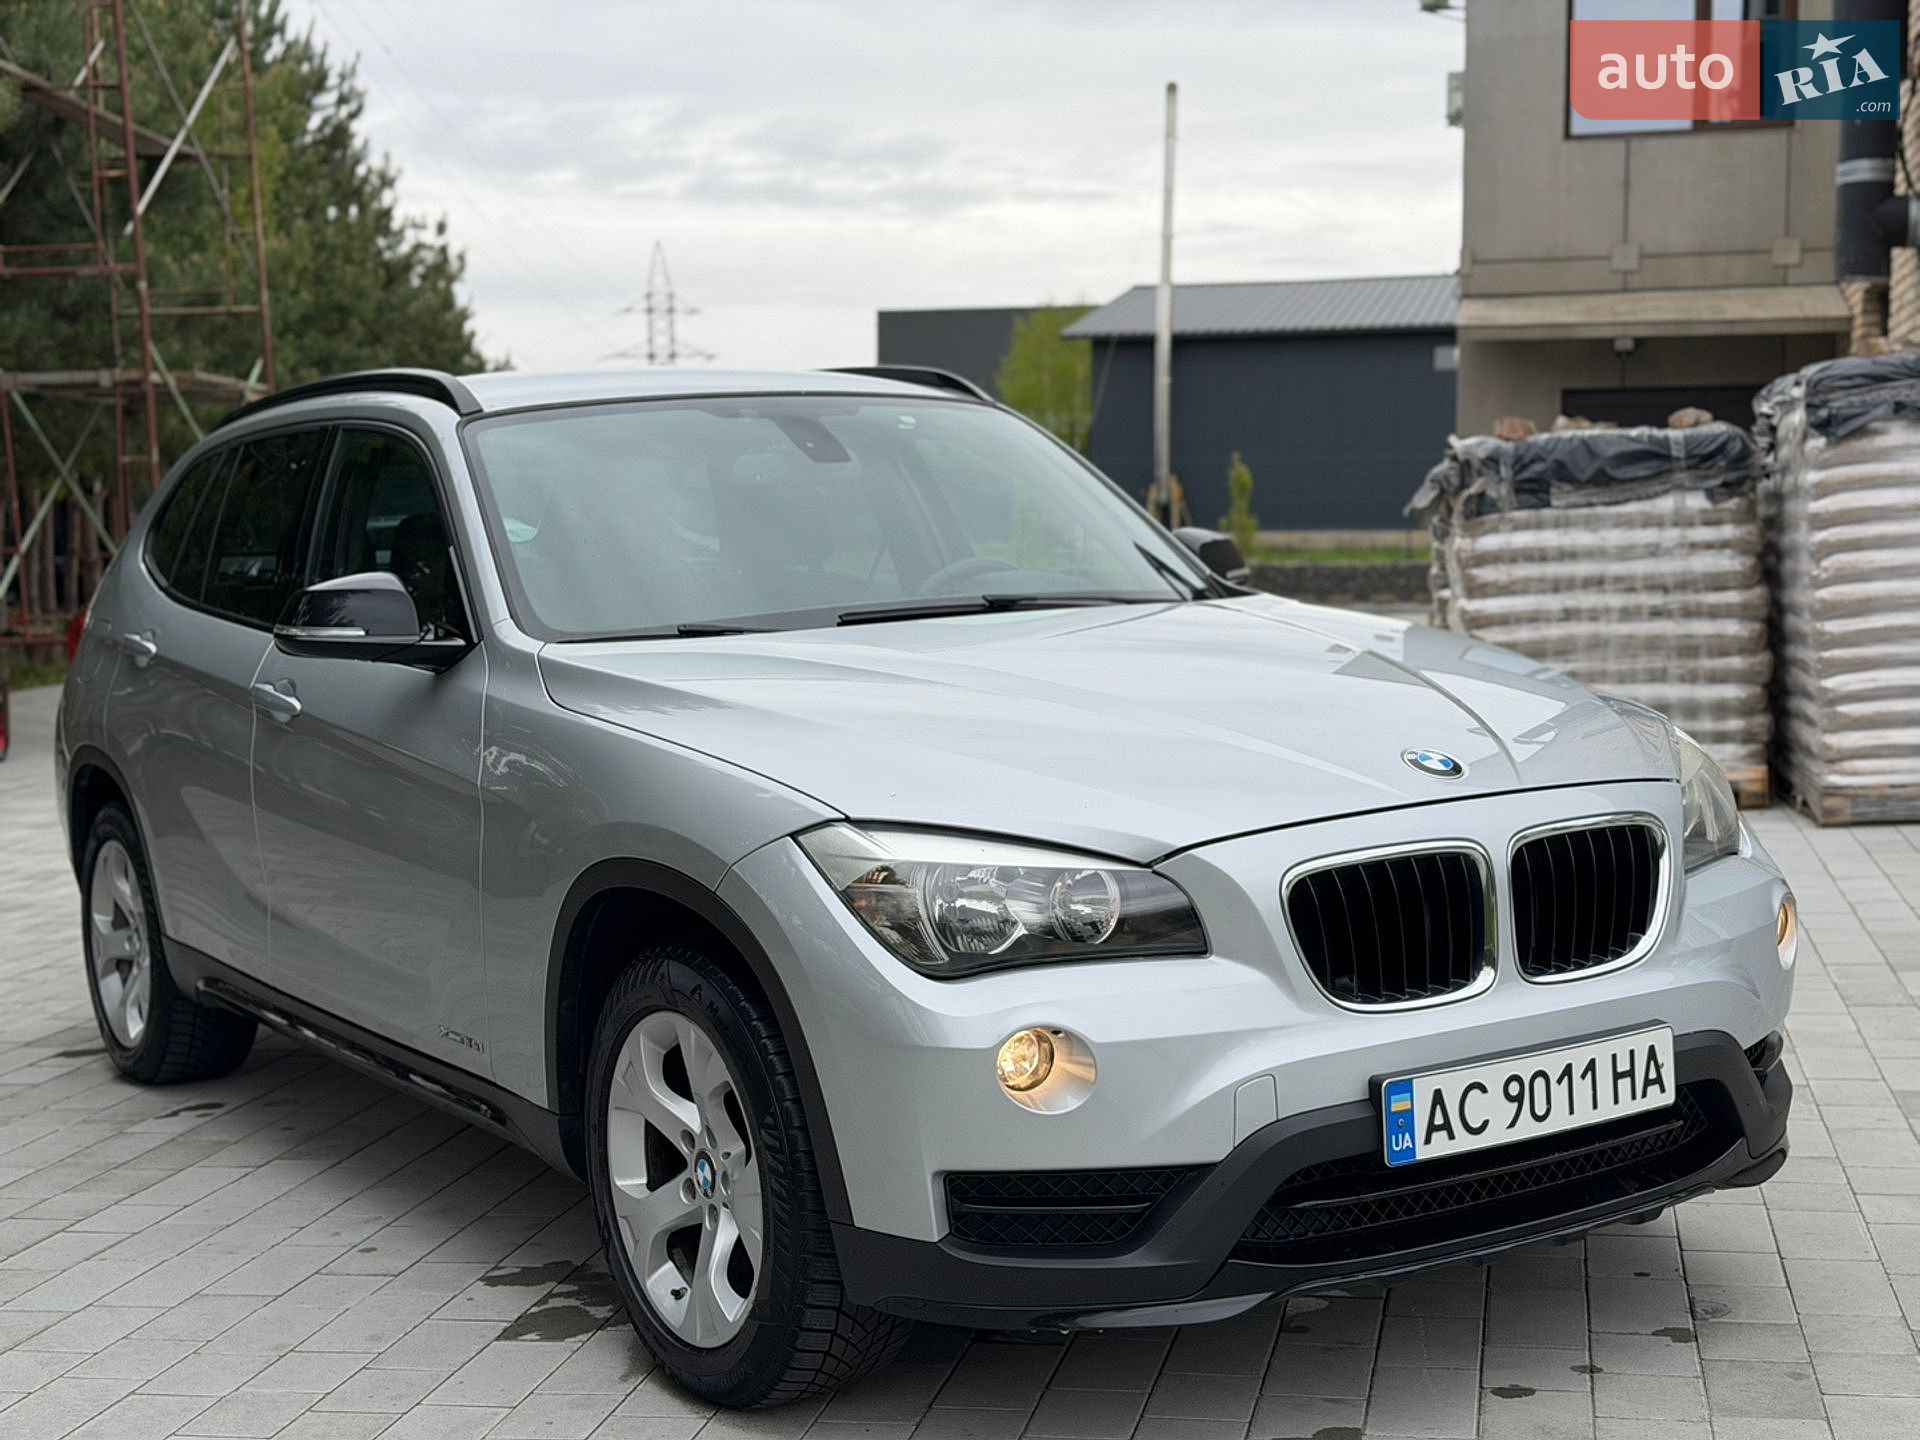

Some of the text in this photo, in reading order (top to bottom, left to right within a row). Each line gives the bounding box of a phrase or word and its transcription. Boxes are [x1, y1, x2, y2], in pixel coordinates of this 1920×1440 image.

[1423, 1044, 1667, 1145] AC 9011 HA
[1391, 1132, 1413, 1151] UA
